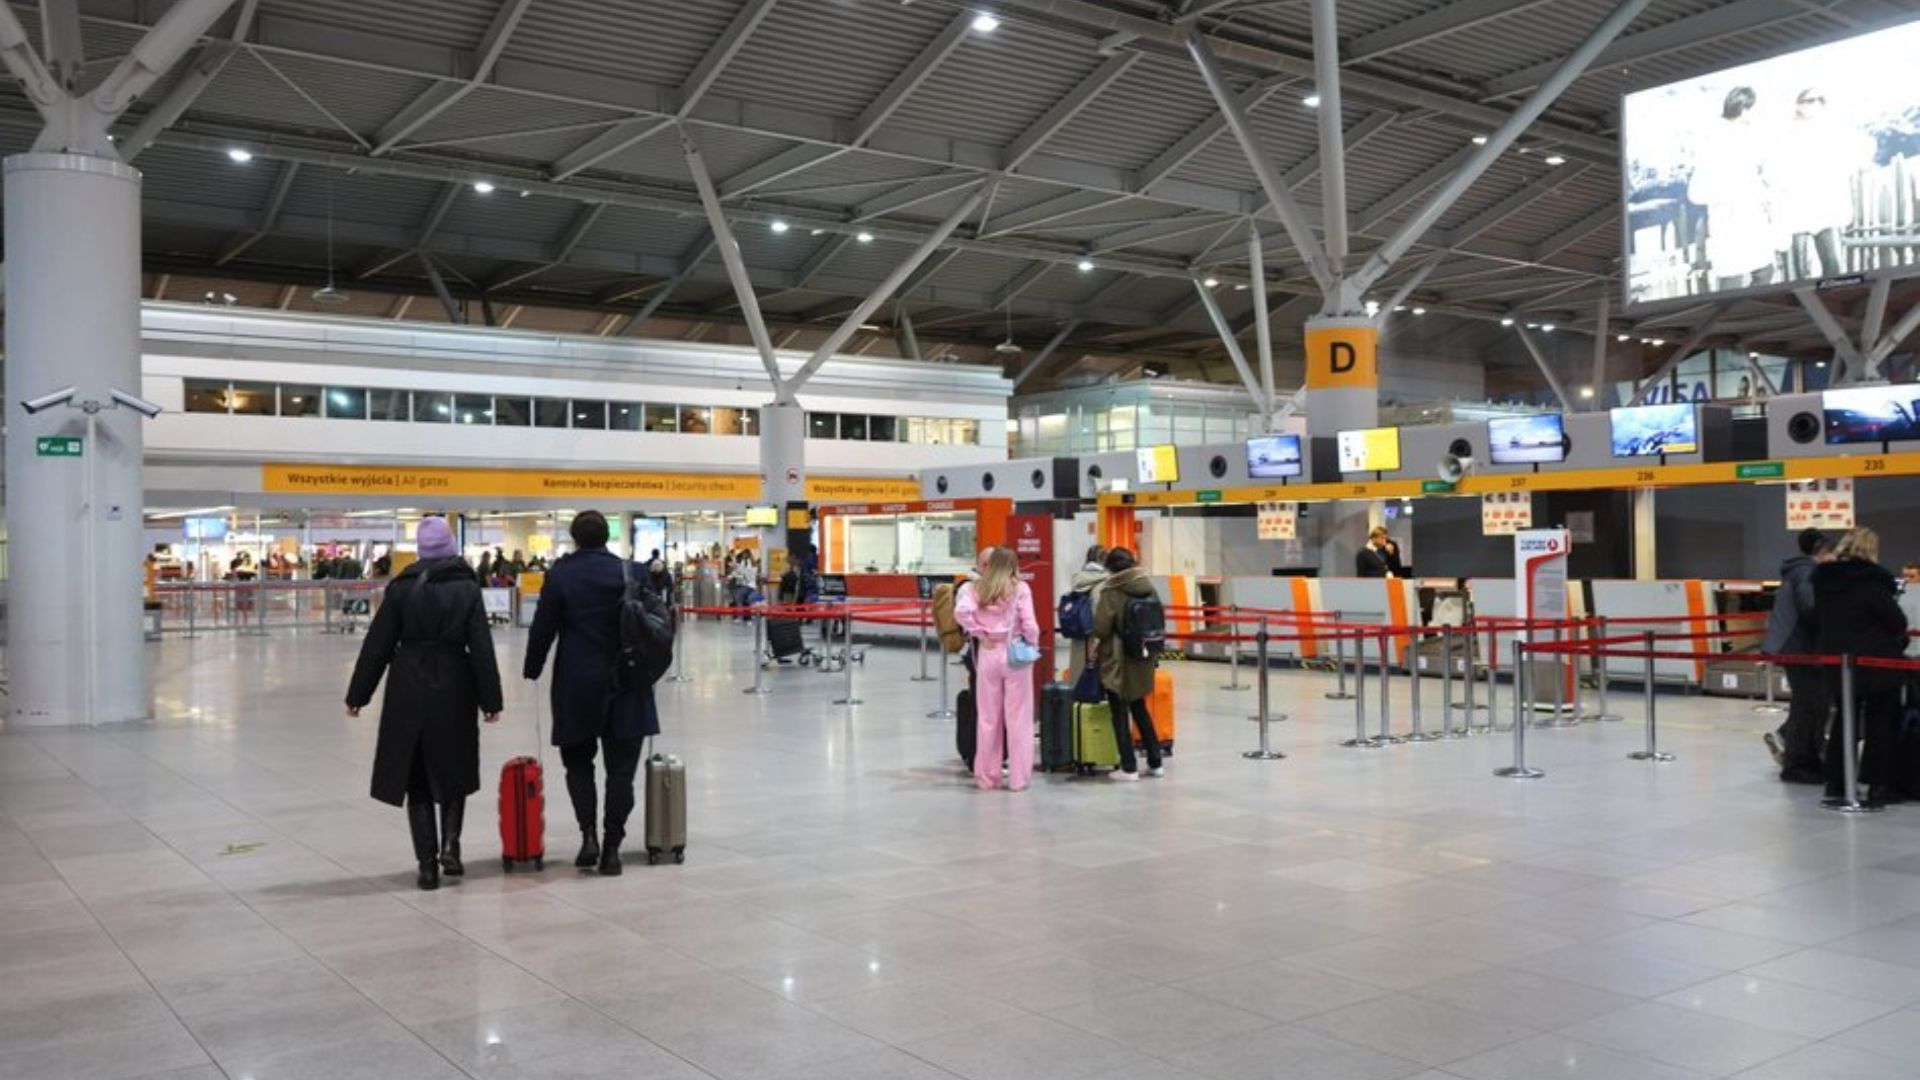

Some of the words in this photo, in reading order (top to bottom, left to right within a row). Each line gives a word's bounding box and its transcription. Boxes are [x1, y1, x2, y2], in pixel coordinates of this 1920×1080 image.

[1329, 341, 1356, 374] D
[1864, 459, 1886, 471] 235
[287, 473, 348, 486] Wszystkie
[350, 473, 393, 488] wyjścia
[401, 475, 417, 485] All
[419, 477, 449, 489] gates
[543, 478, 586, 489] Kontrola
[588, 479, 664, 491] bezpieczeństwa
[671, 480, 707, 492] Security
[709, 481, 735, 491] check
[1510, 477, 1527, 488] 237
[813, 483, 853, 496] Wszystkie
